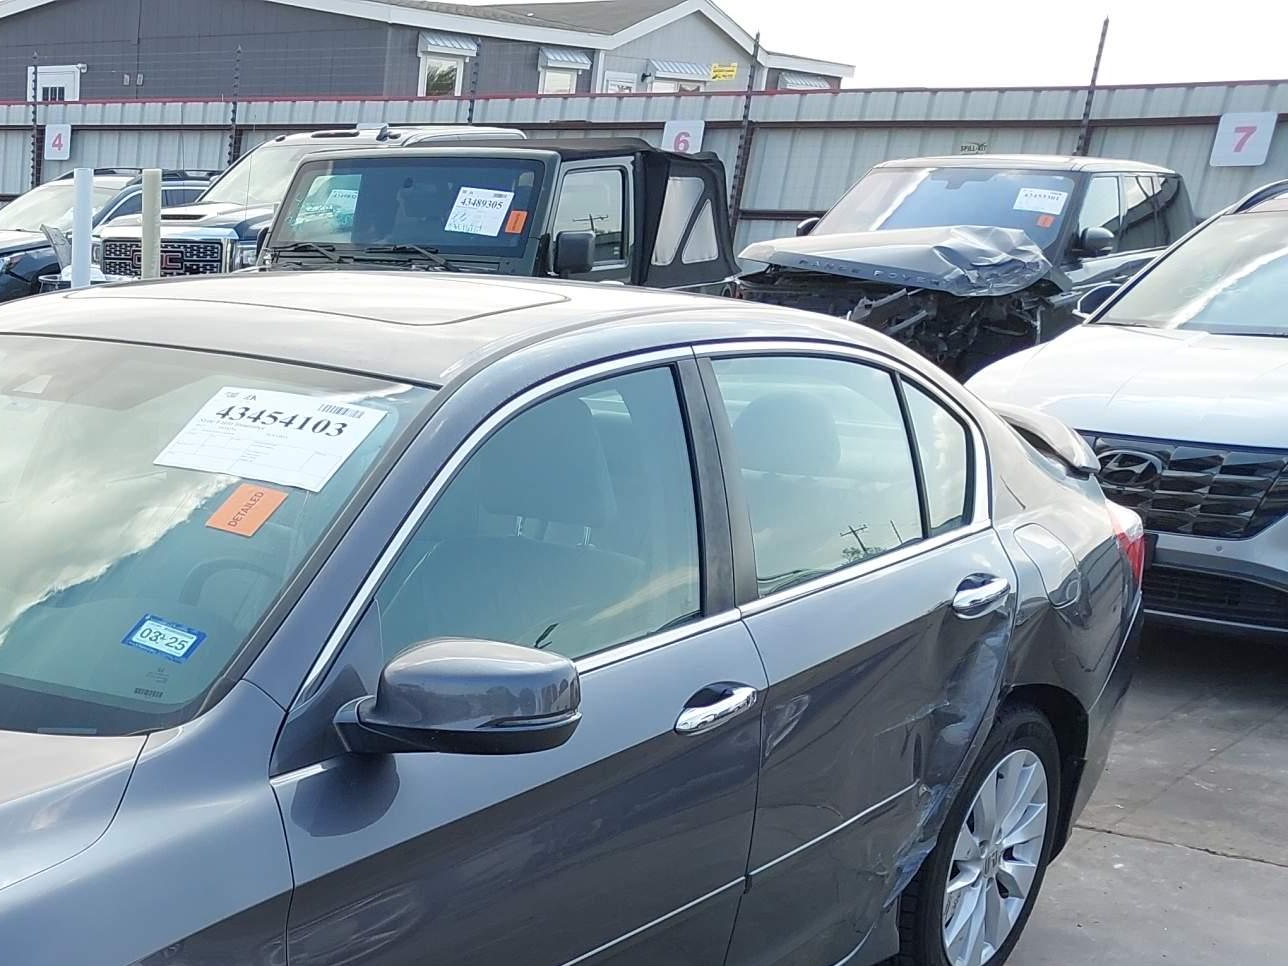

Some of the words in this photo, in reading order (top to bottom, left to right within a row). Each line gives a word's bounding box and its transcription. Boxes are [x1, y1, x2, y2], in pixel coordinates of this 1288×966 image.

[51, 133, 64, 151] 4
[673, 131, 691, 152] 6
[1234, 126, 1257, 152] 7
[215, 404, 348, 438] 43454103
[227, 491, 264, 527] DETAILED
[139, 627, 161, 643] 03
[164, 636, 189, 651] 25
